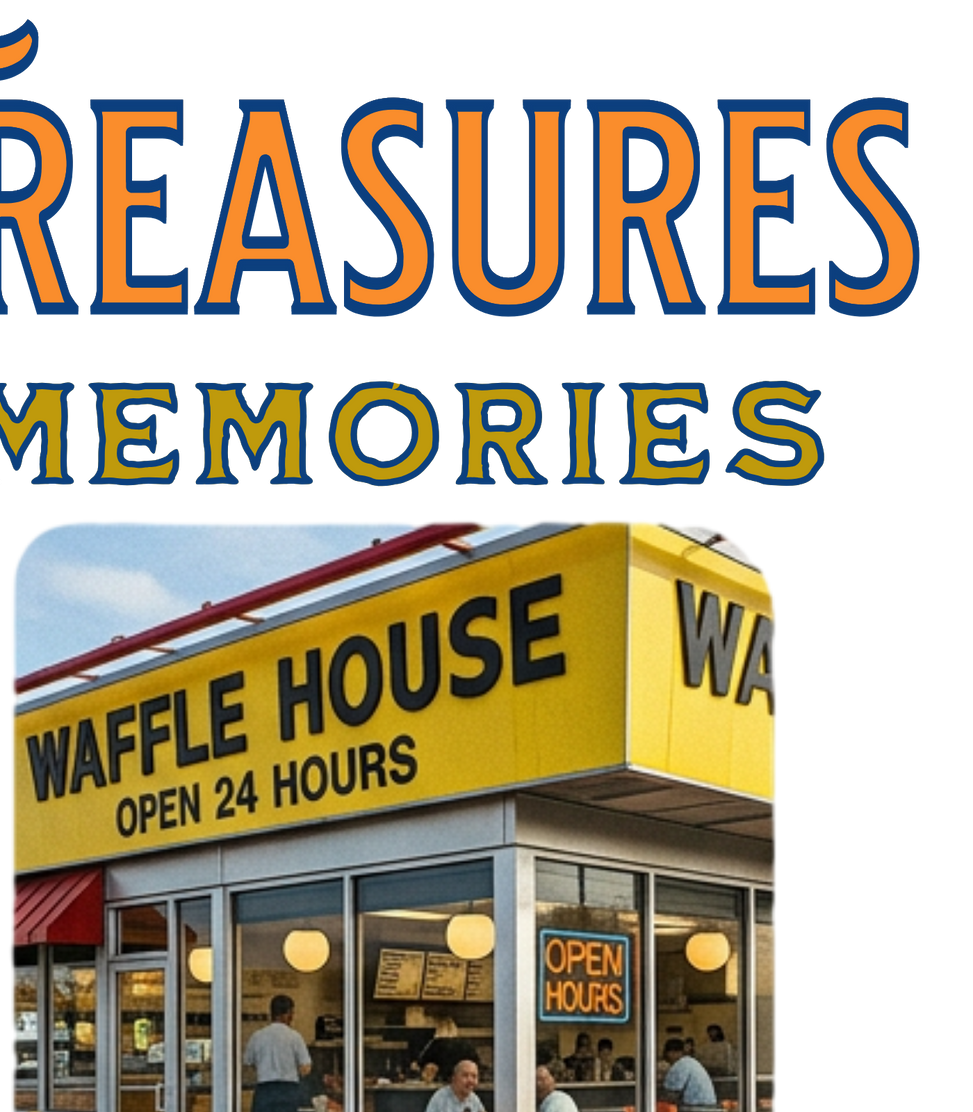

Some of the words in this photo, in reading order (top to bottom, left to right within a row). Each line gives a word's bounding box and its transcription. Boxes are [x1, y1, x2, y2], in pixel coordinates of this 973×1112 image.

[26, 671, 249, 803] WAFFLE
[277, 573, 567, 742] HOUSE
[116, 782, 202, 838] OPEN
[214, 775, 258, 821] 24
[273, 735, 419, 808] HOURS
[545, 938, 623, 977] OPEN
[545, 980, 624, 1014] HOURS
